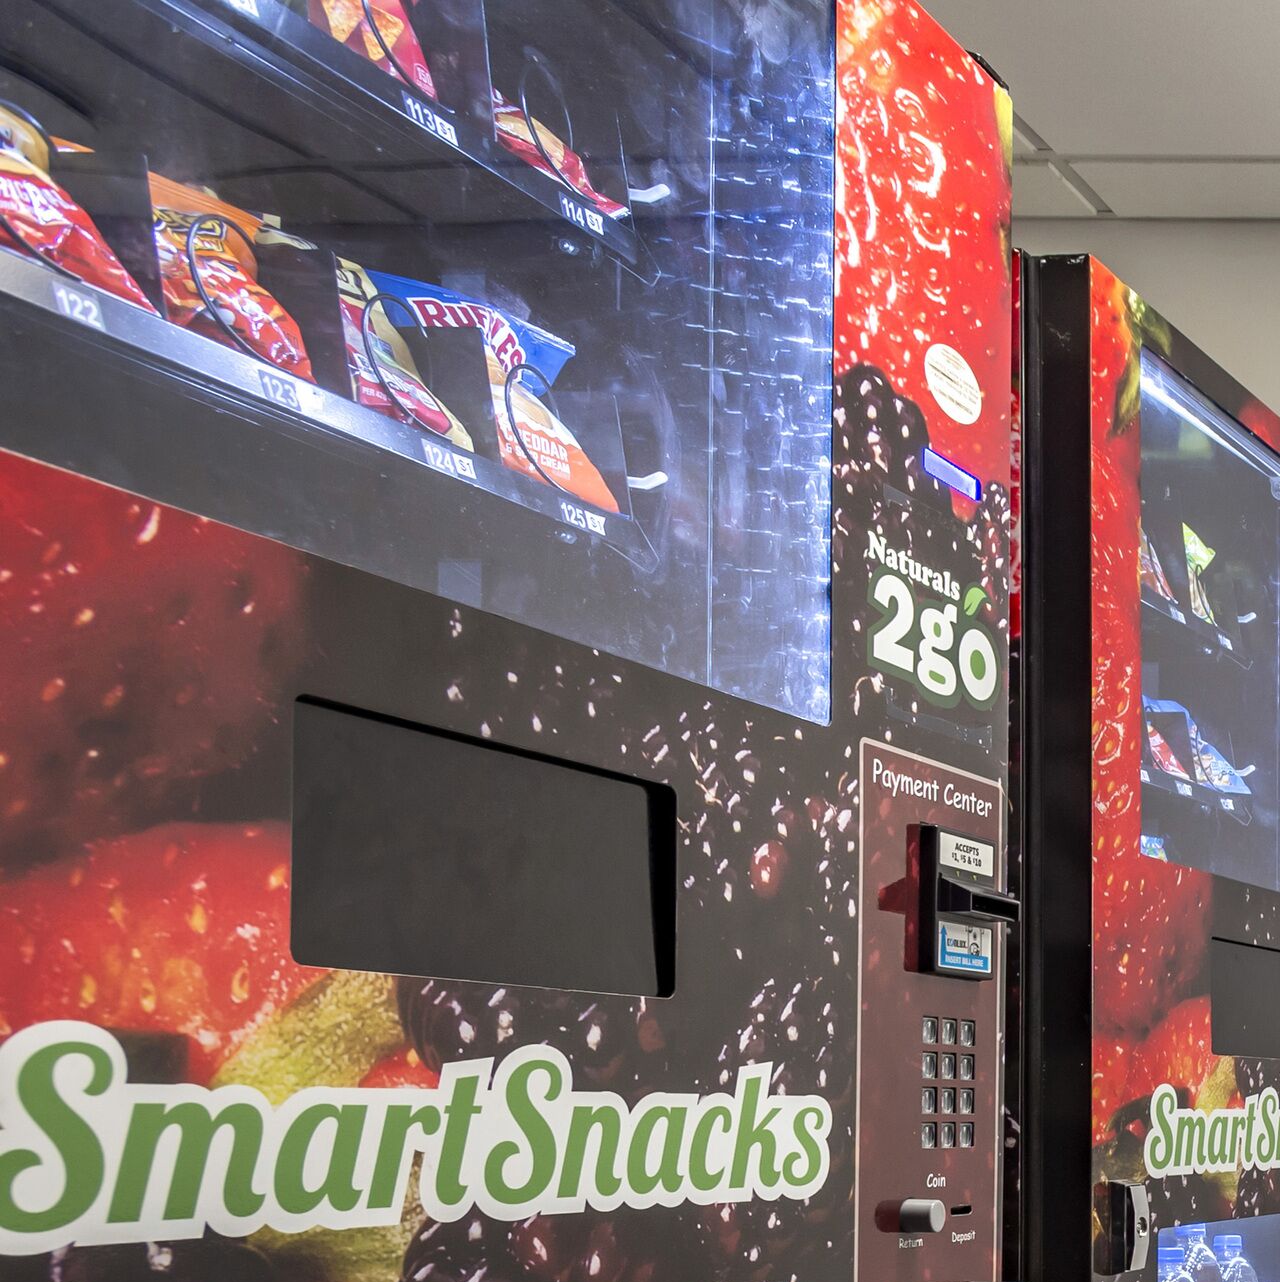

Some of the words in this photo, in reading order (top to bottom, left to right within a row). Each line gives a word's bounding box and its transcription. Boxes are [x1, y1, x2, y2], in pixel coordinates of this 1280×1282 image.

[406, 97, 436, 131] 113
[562, 197, 585, 227] 114
[56, 286, 101, 327] 122
[263, 375, 298, 407] 123
[424, 443, 454, 469] 124
[541, 456, 570, 474] CREAM
[561, 502, 587, 528] 125
[867, 530, 961, 601] Naturals
[873, 574, 997, 701] 2go
[873, 758, 940, 802] Payment
[944, 783, 993, 817] Center
[955, 842, 980, 857] ACCEPTS
[0, 1038, 828, 1236] SmartSnacks
[926, 1173, 946, 1188] Coin
[899, 1238, 924, 1249] Return
[951, 1229, 976, 1244] Deposit
